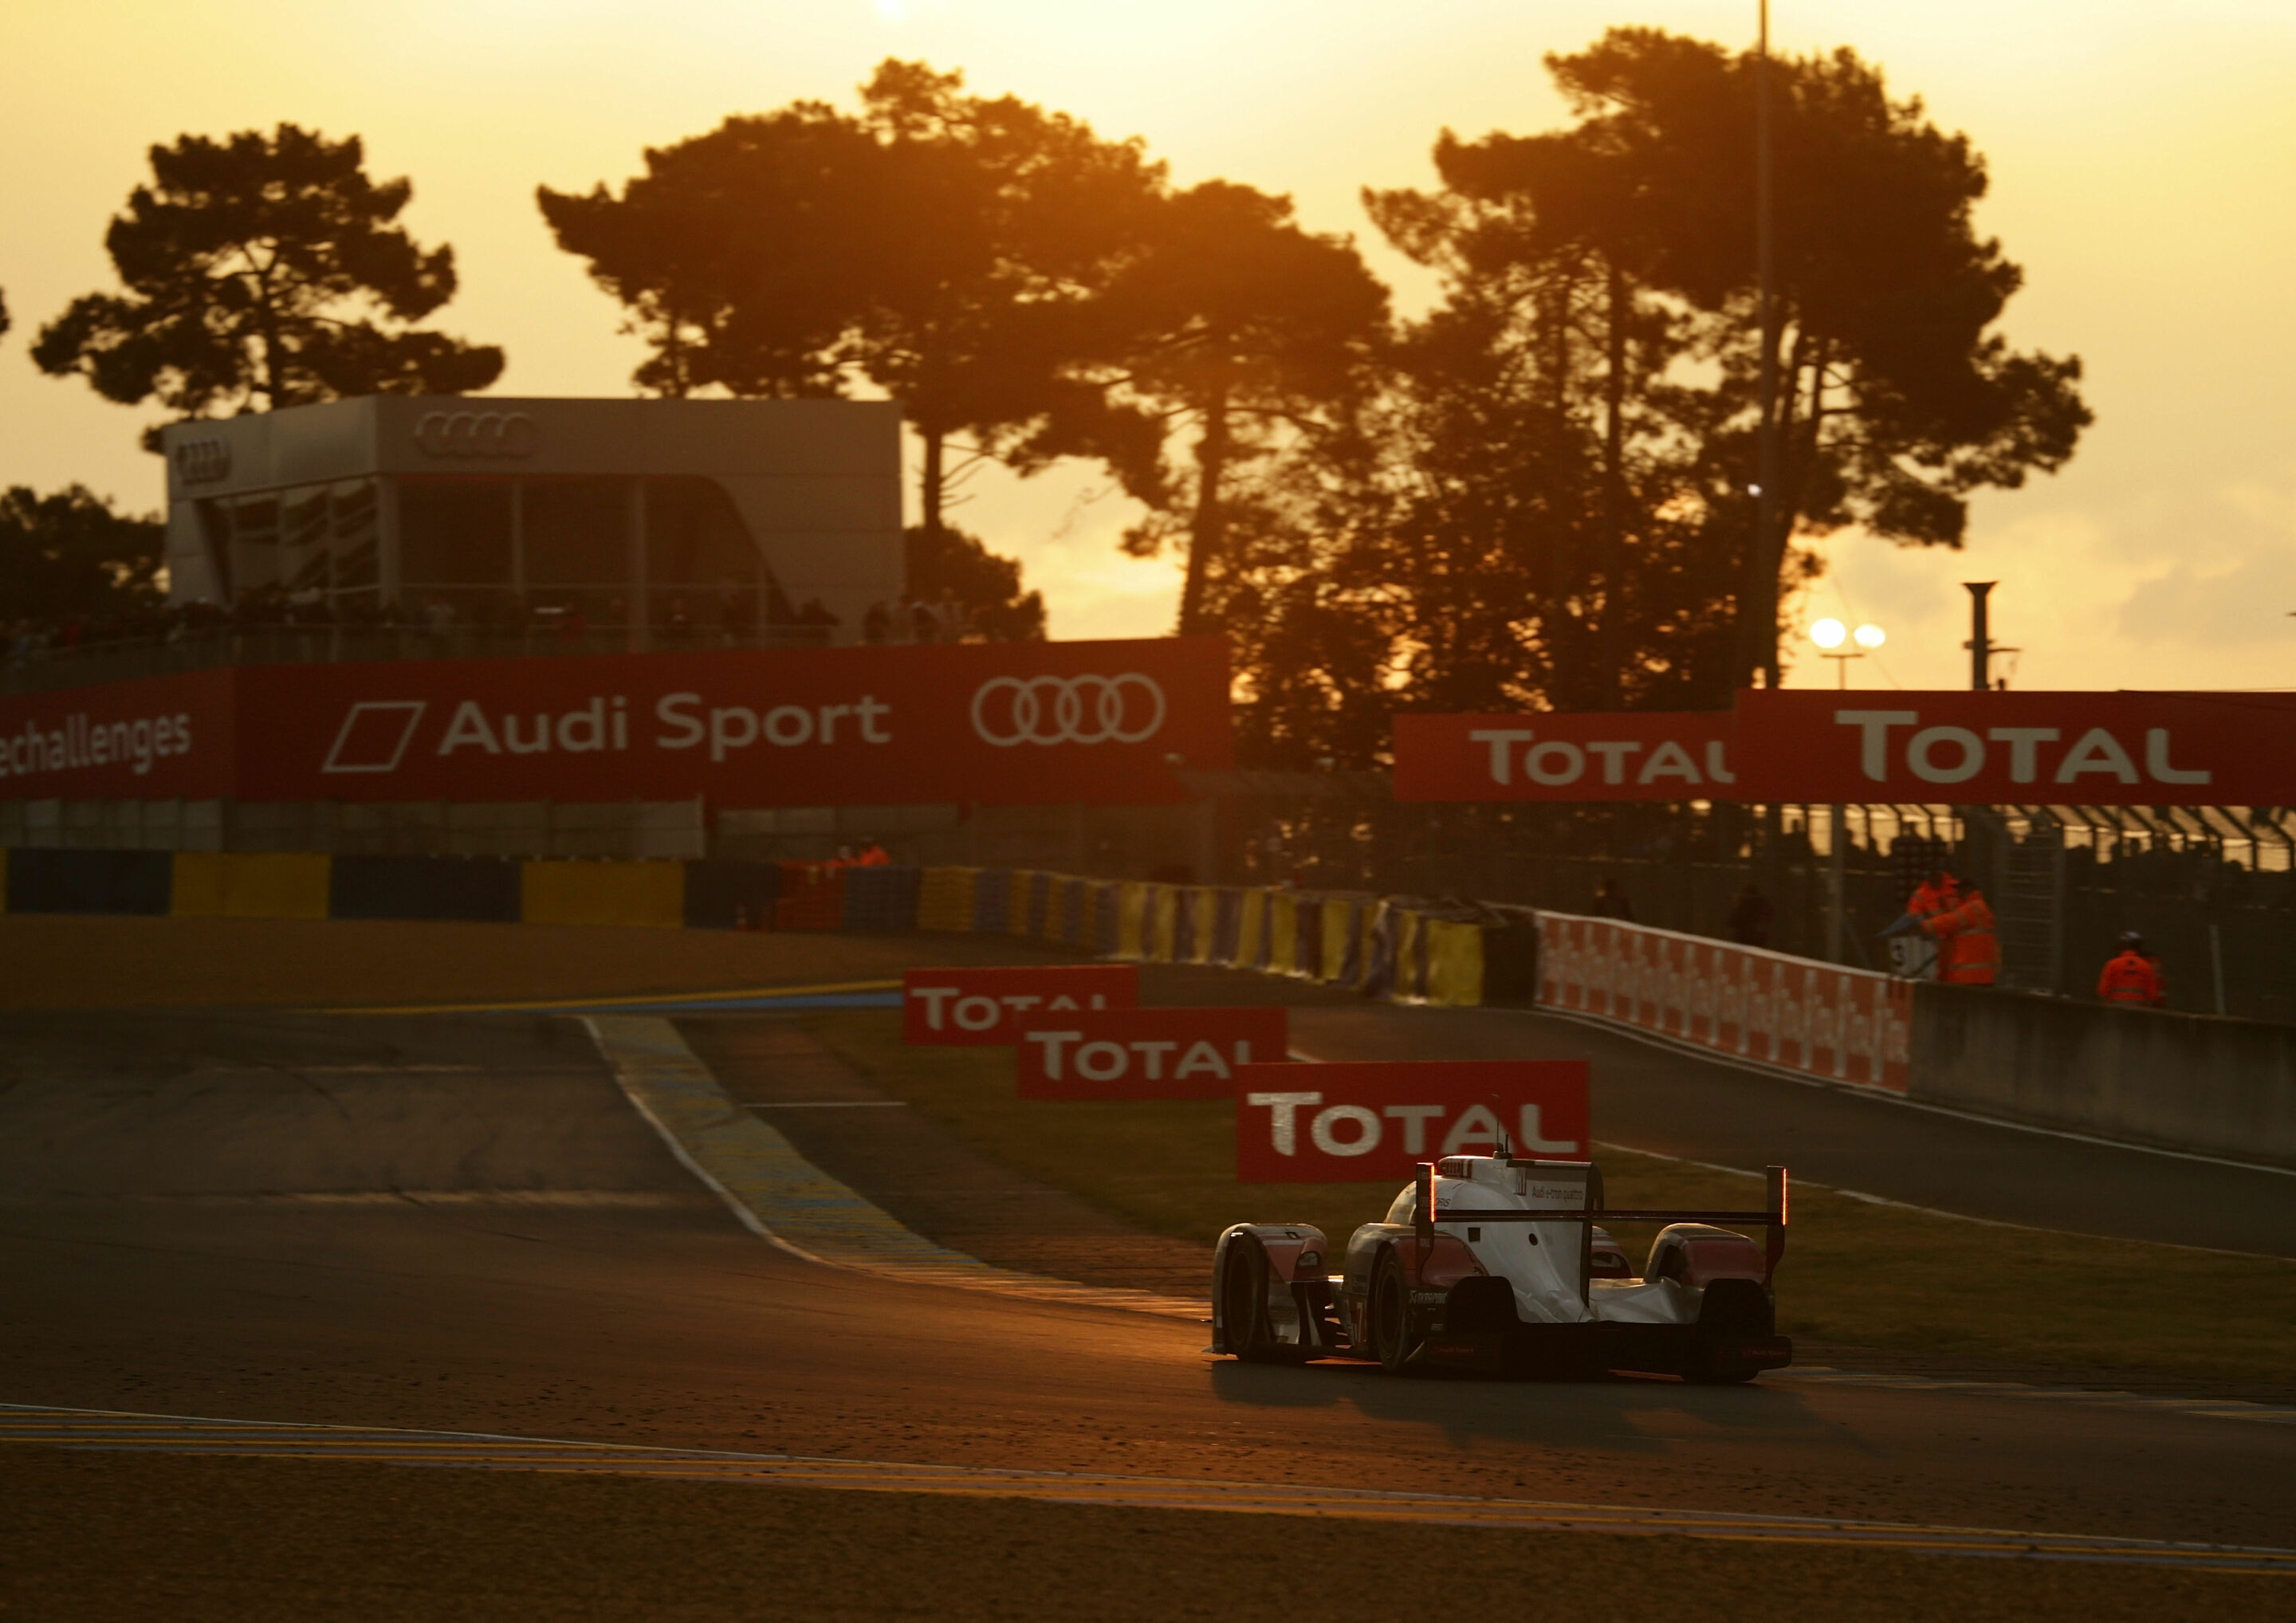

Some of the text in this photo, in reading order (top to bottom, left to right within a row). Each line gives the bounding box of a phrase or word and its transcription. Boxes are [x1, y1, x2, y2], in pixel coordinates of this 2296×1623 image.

[438, 691, 891, 763] Audi Sport
[1834, 709, 2211, 784] TOTAL
[1247, 1091, 1578, 1157] TOTAL
